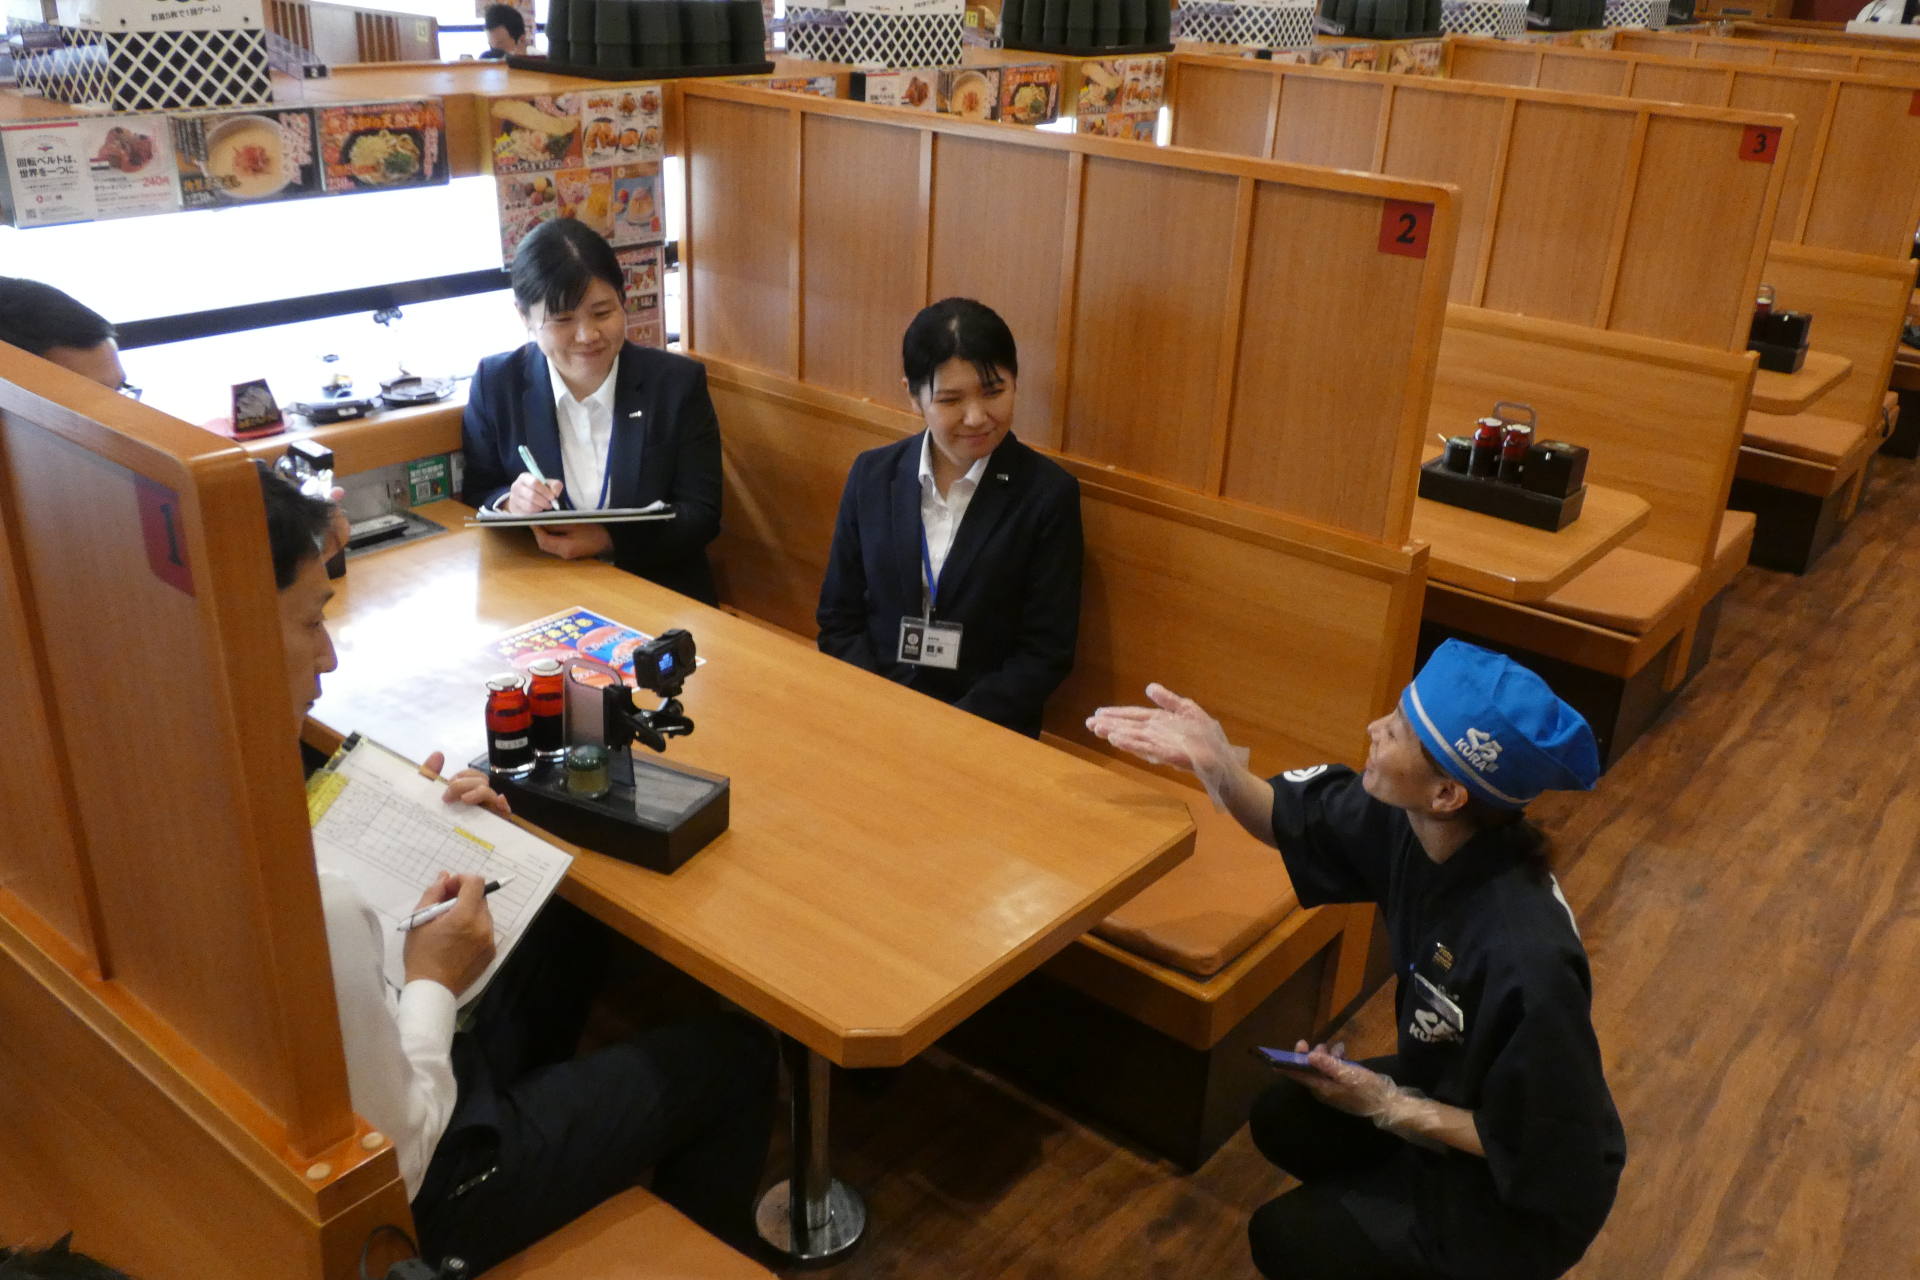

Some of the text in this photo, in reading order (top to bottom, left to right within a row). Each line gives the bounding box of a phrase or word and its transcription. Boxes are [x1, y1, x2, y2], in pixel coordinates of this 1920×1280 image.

[1751, 133, 1768, 154] 3
[1396, 213, 1418, 244] 2
[160, 503, 184, 568] 1
[1454, 737, 1487, 772] KURA
